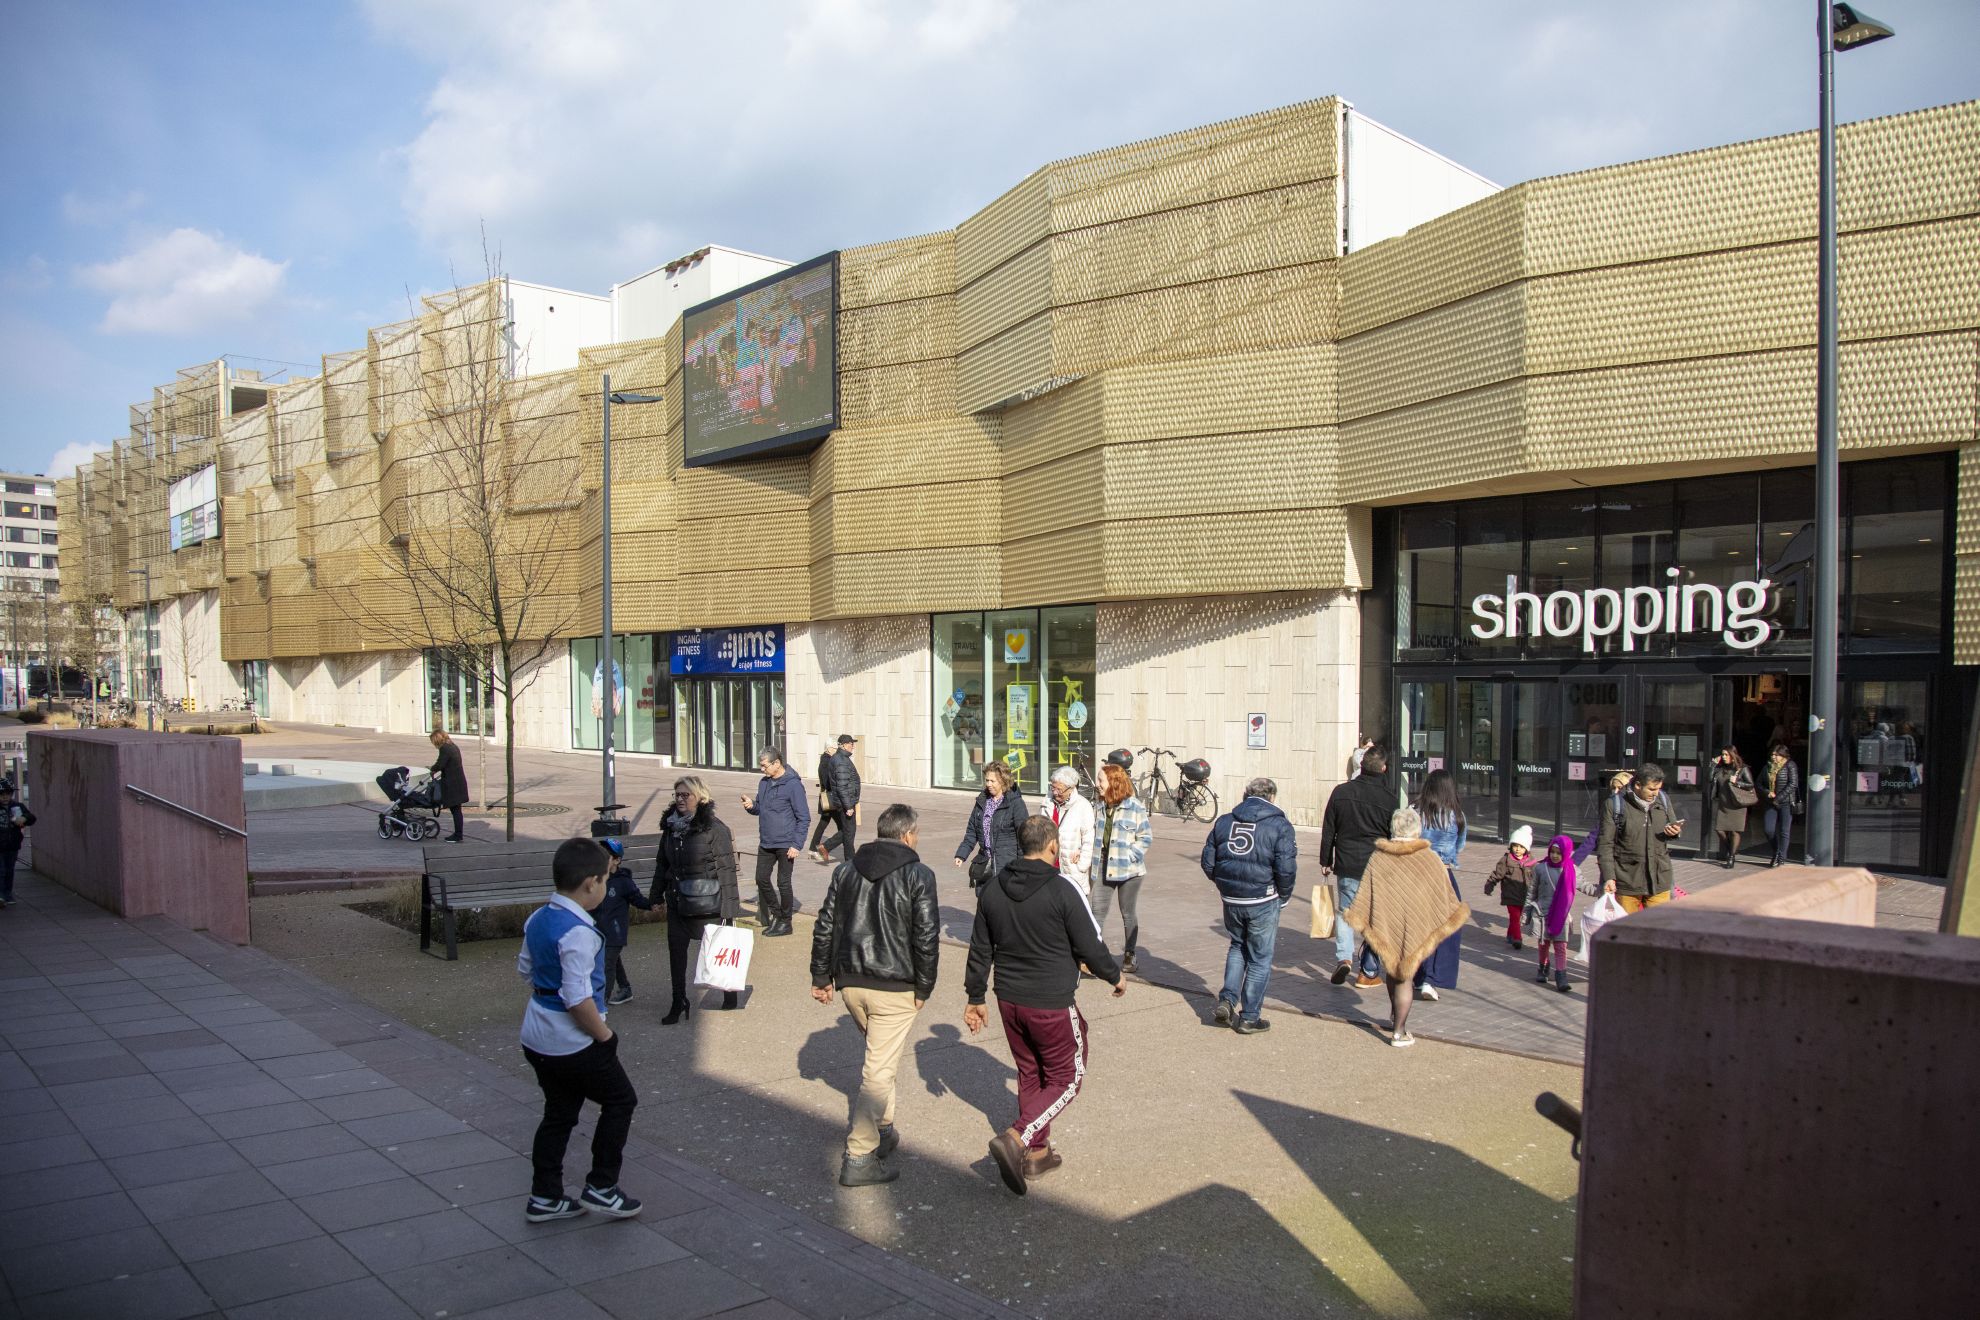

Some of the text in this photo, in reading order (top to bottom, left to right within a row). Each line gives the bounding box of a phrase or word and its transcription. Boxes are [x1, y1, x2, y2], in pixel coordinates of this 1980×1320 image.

[1470, 567, 1770, 652] shopping
[677, 635, 701, 645] INGANG
[677, 645, 701, 656] FITNESS
[732, 630, 775, 668] jims
[738, 660, 773, 670] enjoy fitness
[1461, 762, 1494, 771] Welkom
[1517, 764, 1551, 773] Welkom
[1228, 822, 1256, 855] 5
[714, 947, 741, 968] H&M
